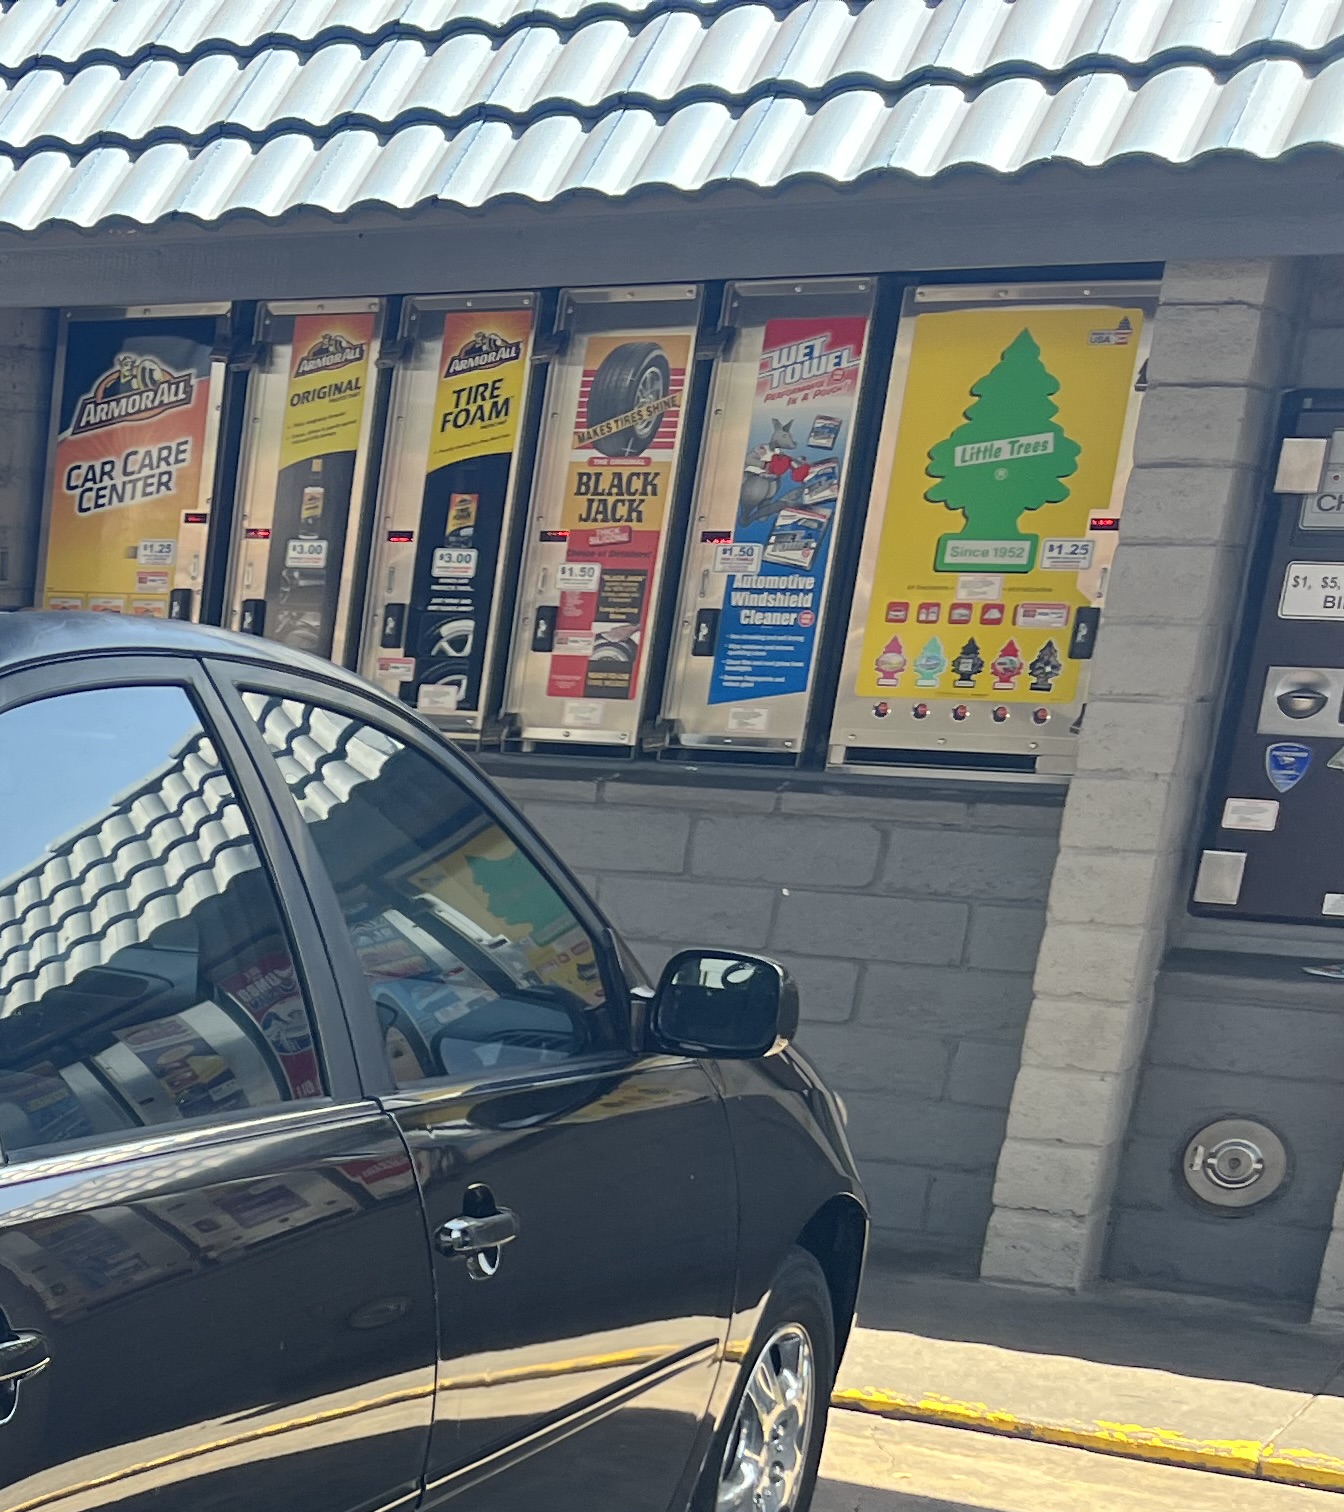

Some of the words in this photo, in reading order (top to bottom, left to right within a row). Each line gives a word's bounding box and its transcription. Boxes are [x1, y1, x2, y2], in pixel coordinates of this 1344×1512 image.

[769, 335, 828, 369] WET
[771, 348, 854, 390] TOWEL
[289, 376, 362, 407] ORIGINAL
[452, 377, 504, 409] TIRE
[440, 397, 511, 433] FOAM
[577, 422, 612, 443] MAKES
[613, 409, 644, 430] TIRES
[645, 395, 678, 417] SHINE
[960, 442, 1002, 464] Little
[1008, 438, 1049, 457] Trees
[65, 459, 116, 491] CAR
[121, 439, 190, 477] CARE
[76, 469, 173, 514] CENTER
[574, 472, 660, 497] BLACK
[578, 498, 645, 523] JACK
[143, 543, 172, 554] $1.25
[292, 544, 323, 555] $3.00
[439, 553, 472, 564] $3.00
[722, 546, 755, 557] $1.50
[950, 546, 989, 557] Since
[993, 546, 1026, 558] 1952
[1048, 543, 1090, 556] $1.25
[560, 566, 596, 578] $1.50
[733, 573, 815, 590] Automotive
[730, 591, 814, 608] Windshield
[739, 609, 798, 626] Cleaner
